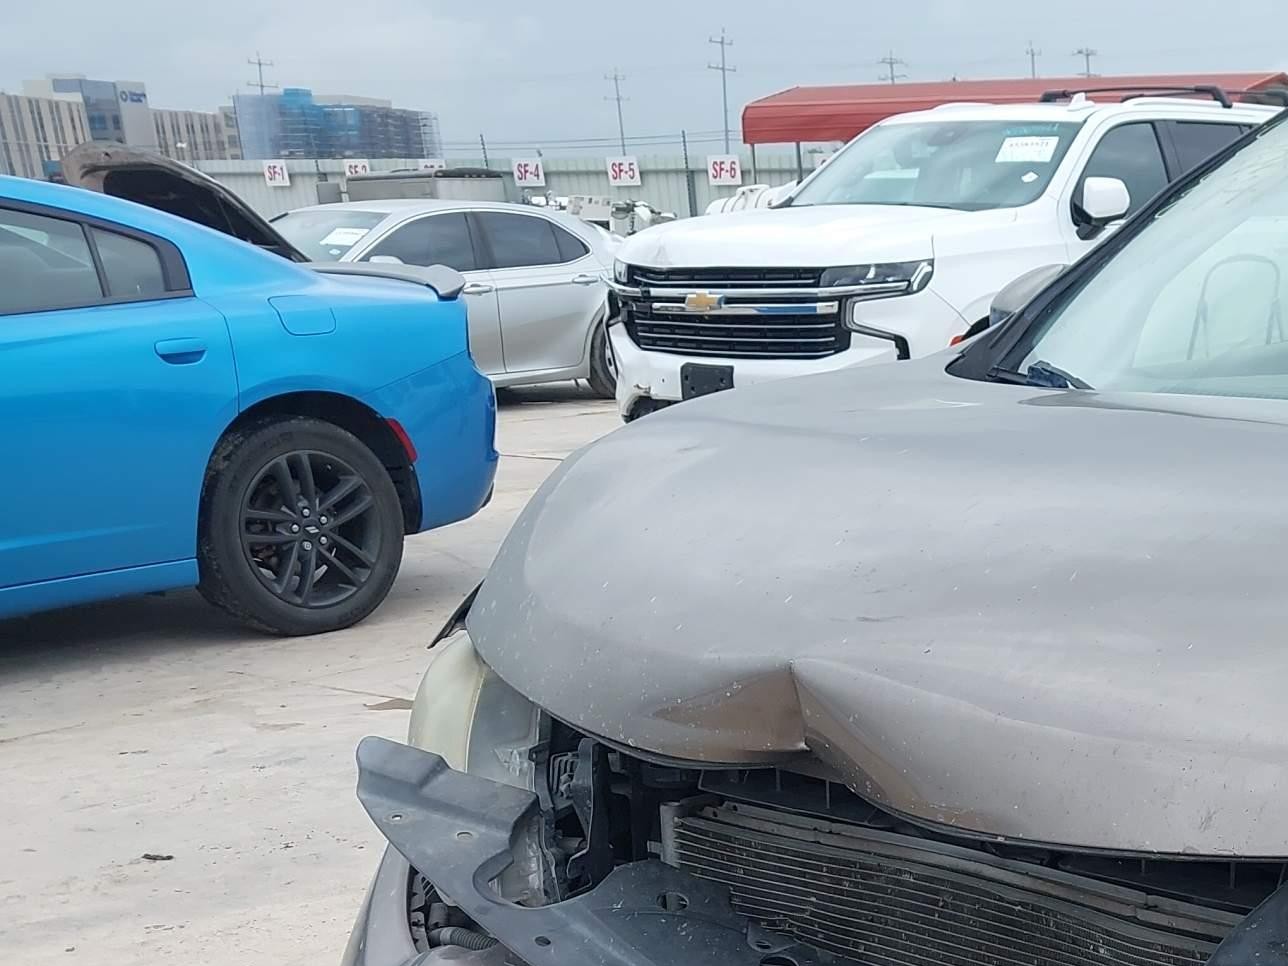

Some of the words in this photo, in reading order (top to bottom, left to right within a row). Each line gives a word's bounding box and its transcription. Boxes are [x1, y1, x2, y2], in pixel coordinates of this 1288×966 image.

[267, 165, 285, 181] SF-1
[516, 163, 541, 181] SF-4
[611, 162, 636, 181] SF-5
[712, 160, 737, 179] SF-6
